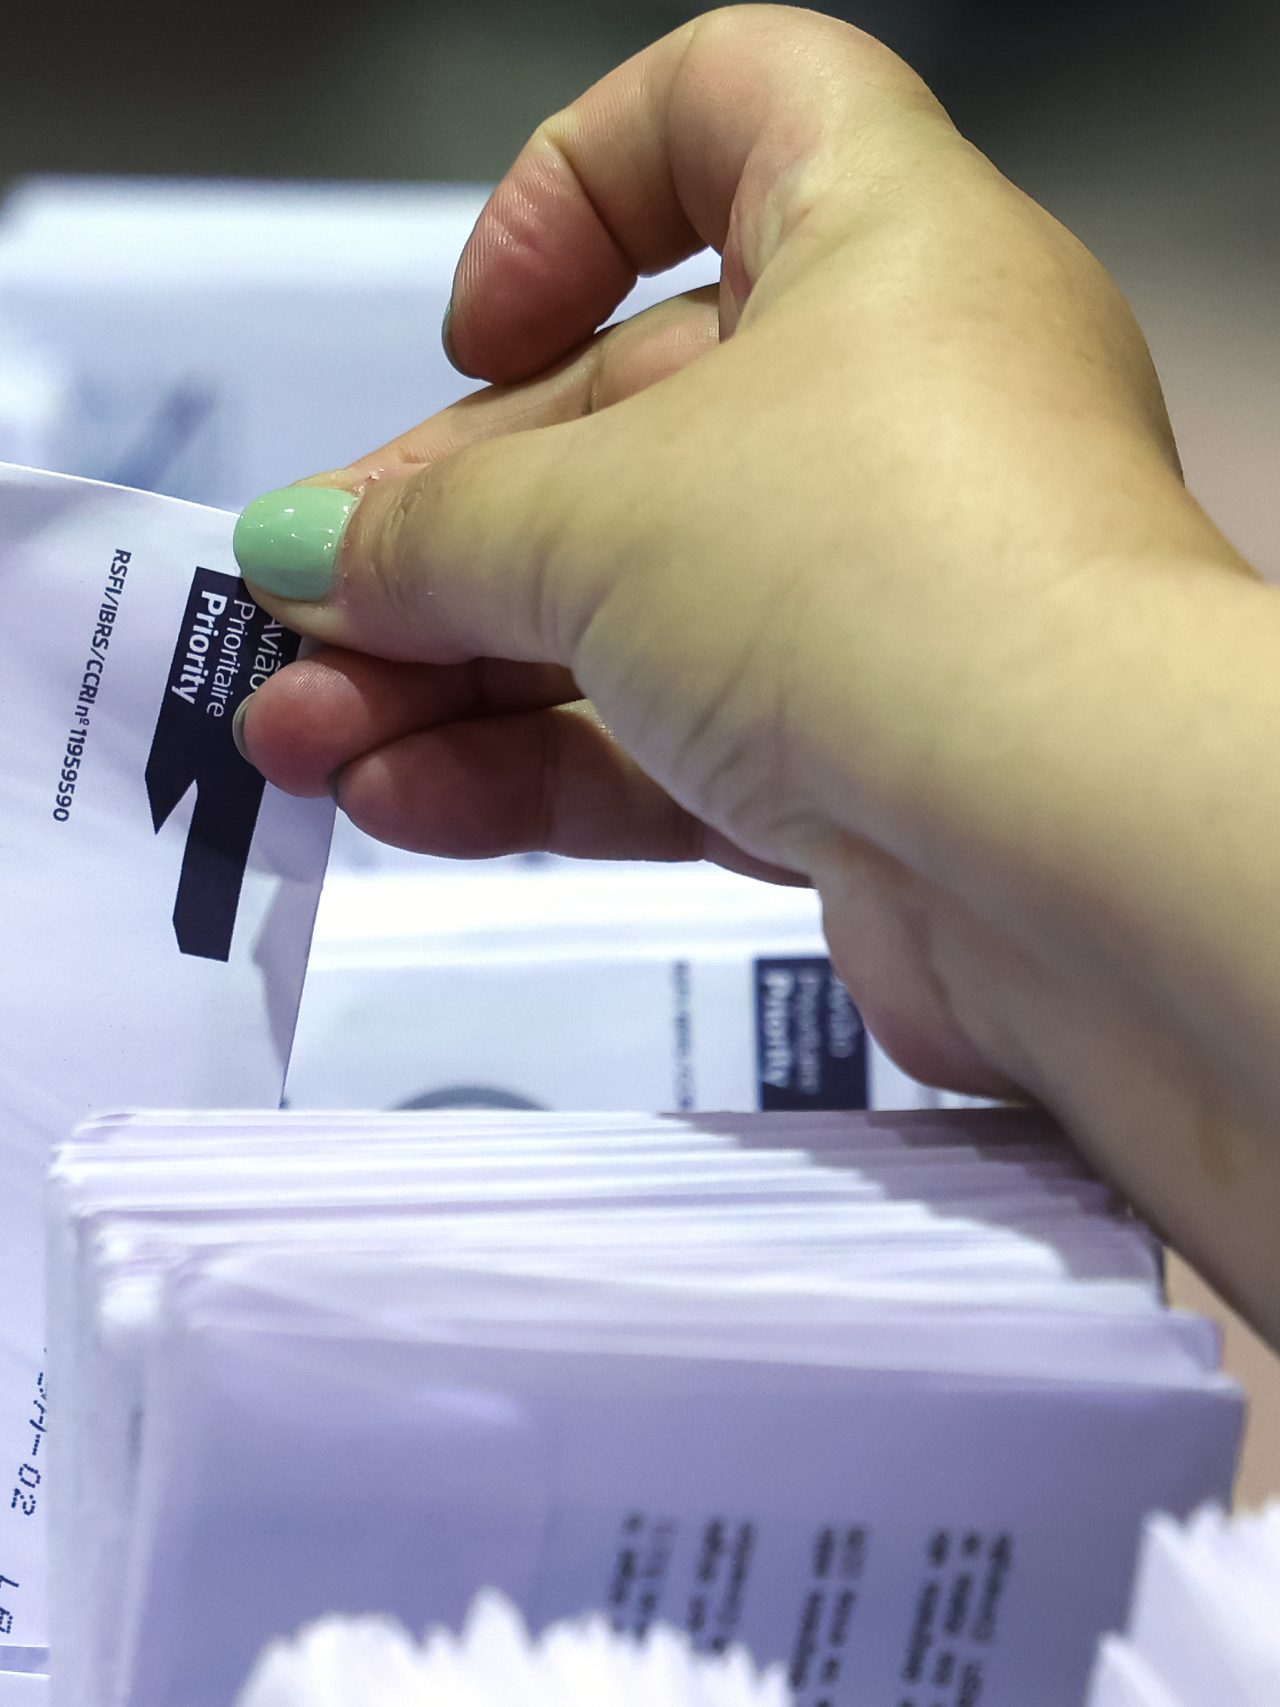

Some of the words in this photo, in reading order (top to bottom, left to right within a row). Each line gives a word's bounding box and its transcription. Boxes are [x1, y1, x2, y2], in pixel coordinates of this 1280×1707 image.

[77, 548, 132, 705] RSFI/IBRS/CCRI
[171, 590, 228, 705] Priority
[206, 599, 256, 717] Prioritaire
[52, 728, 88, 823] 11959590
